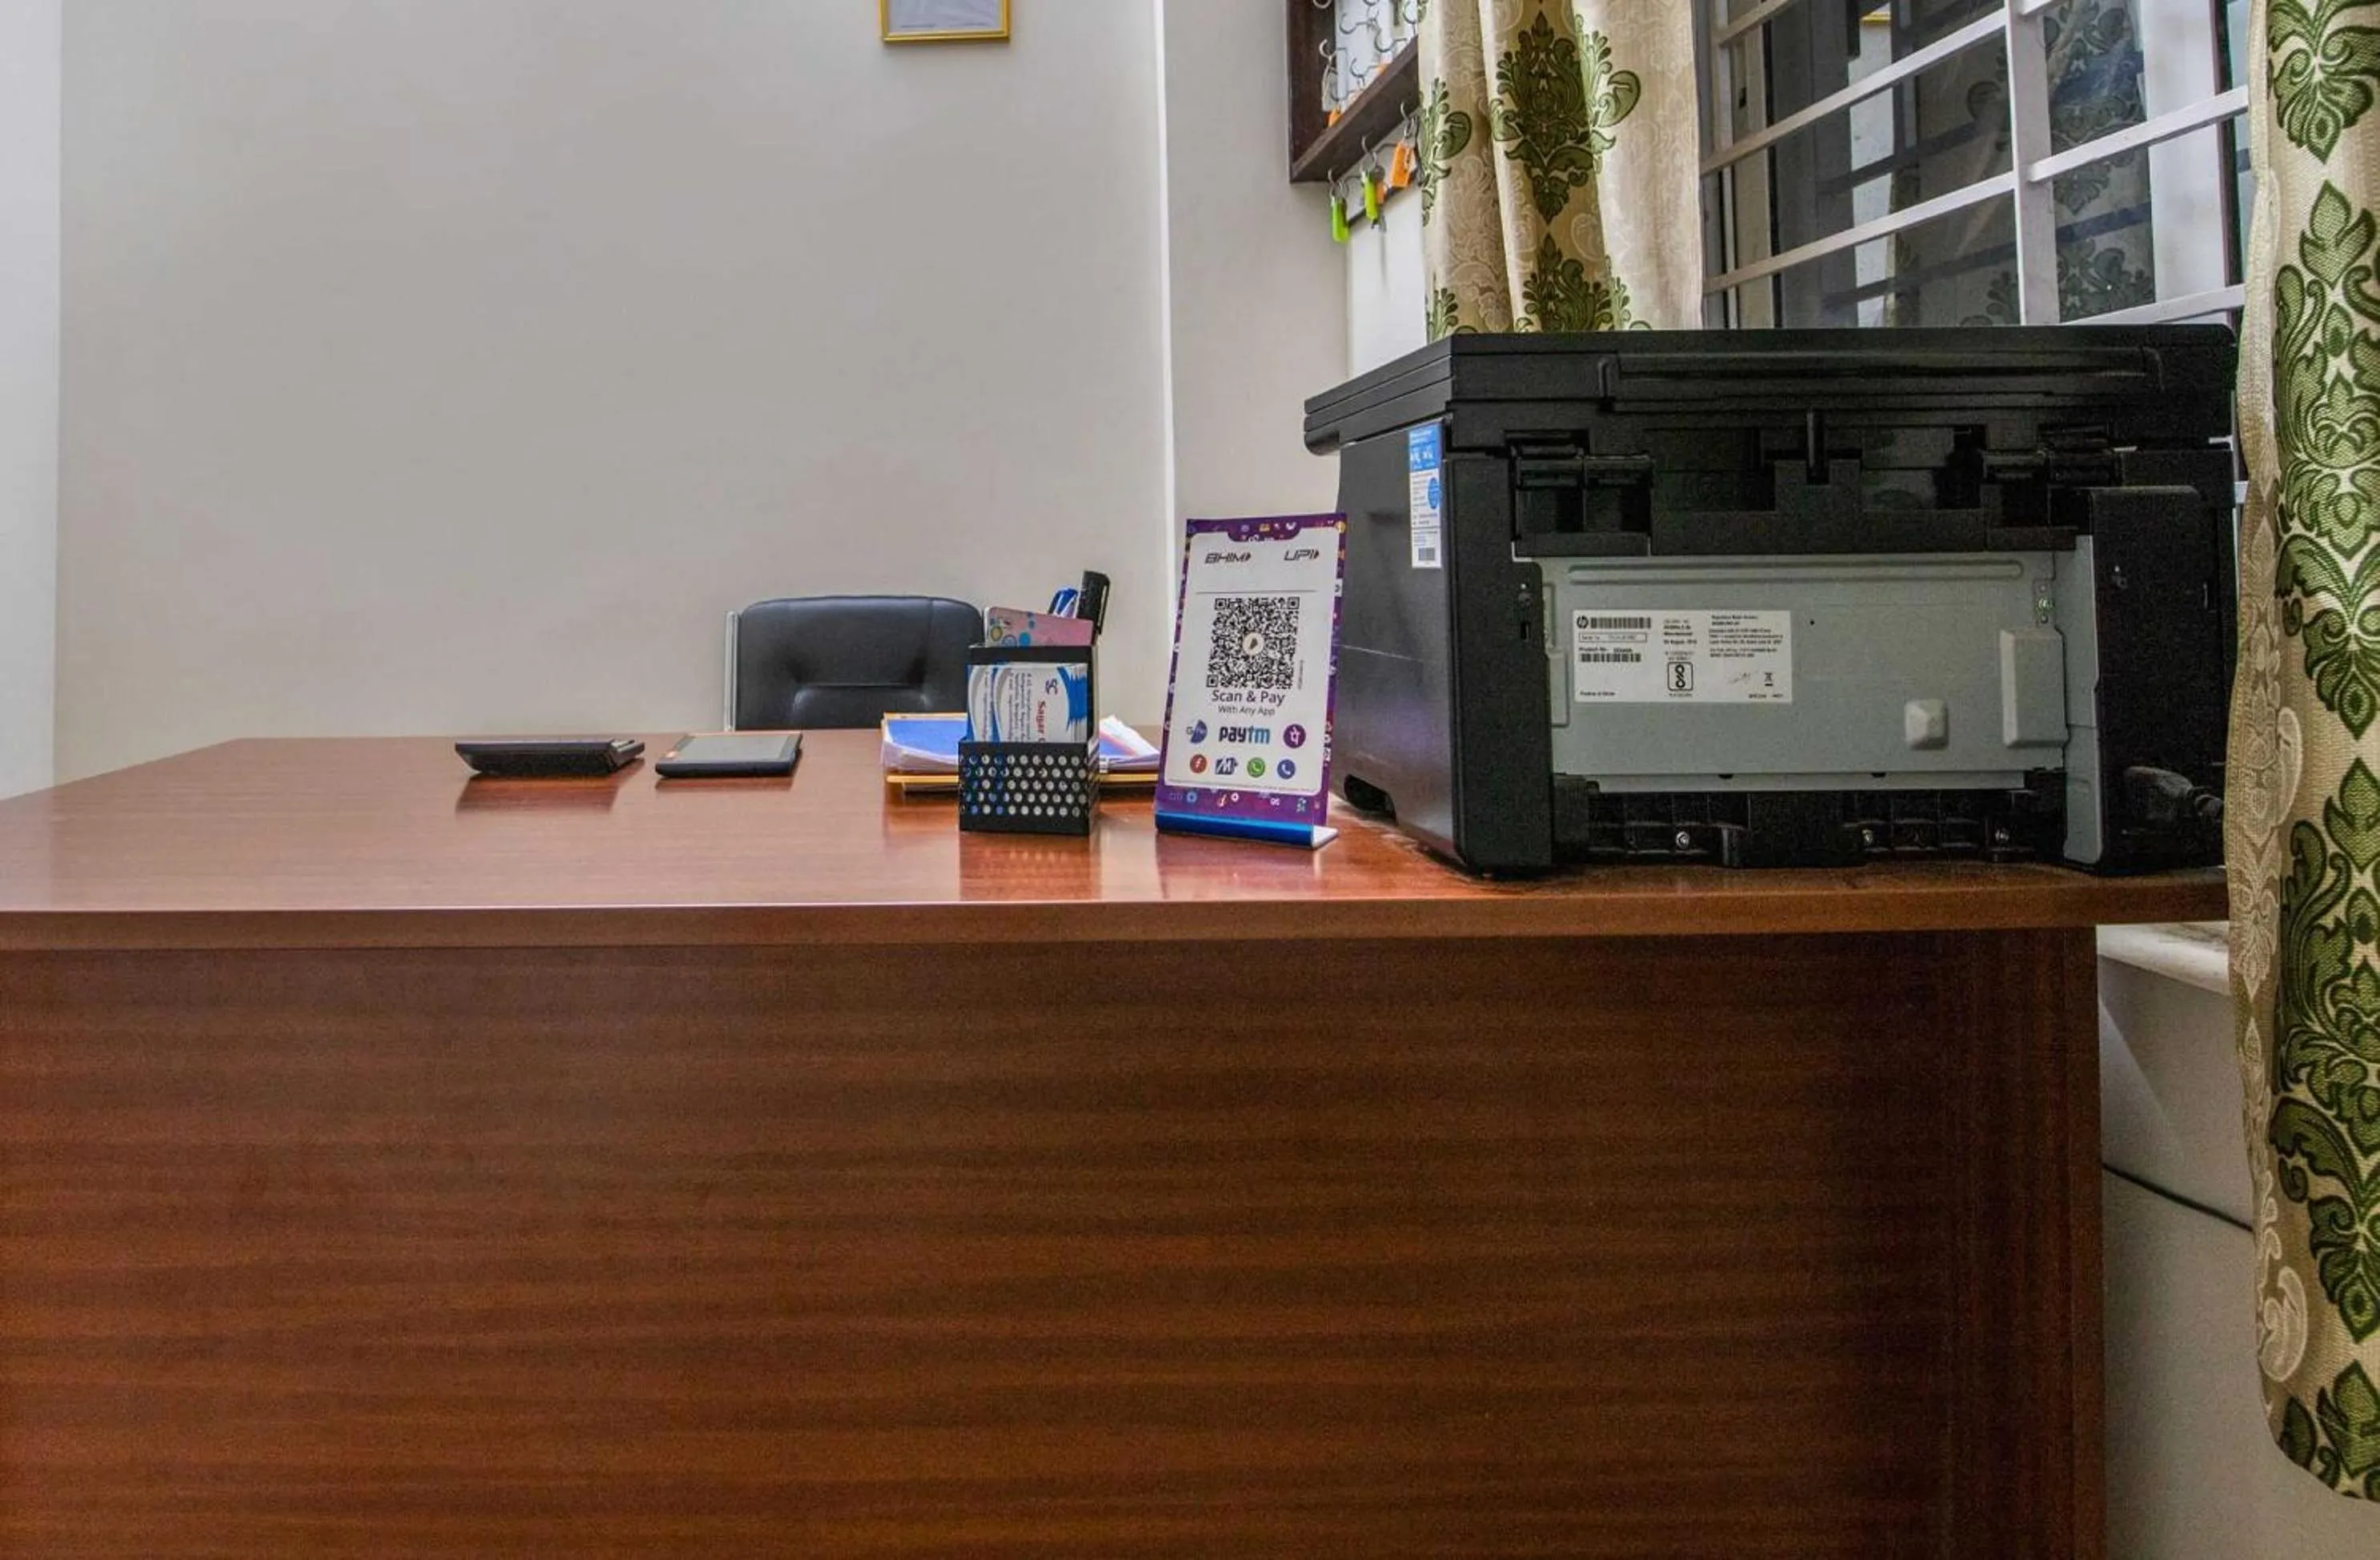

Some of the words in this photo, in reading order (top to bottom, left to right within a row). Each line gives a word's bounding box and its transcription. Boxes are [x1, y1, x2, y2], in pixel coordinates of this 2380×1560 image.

[1205, 552, 1248, 563] BHIM
[1284, 549, 1315, 561] UPI
[1212, 690, 1242, 702] Scan
[1246, 690, 1256, 702] &
[1260, 691, 1285, 707] Pay
[1218, 705, 1237, 714] With
[1239, 707, 1256, 716] Any
[1258, 707, 1276, 717] App
[1219, 725, 1270, 744] paytm
